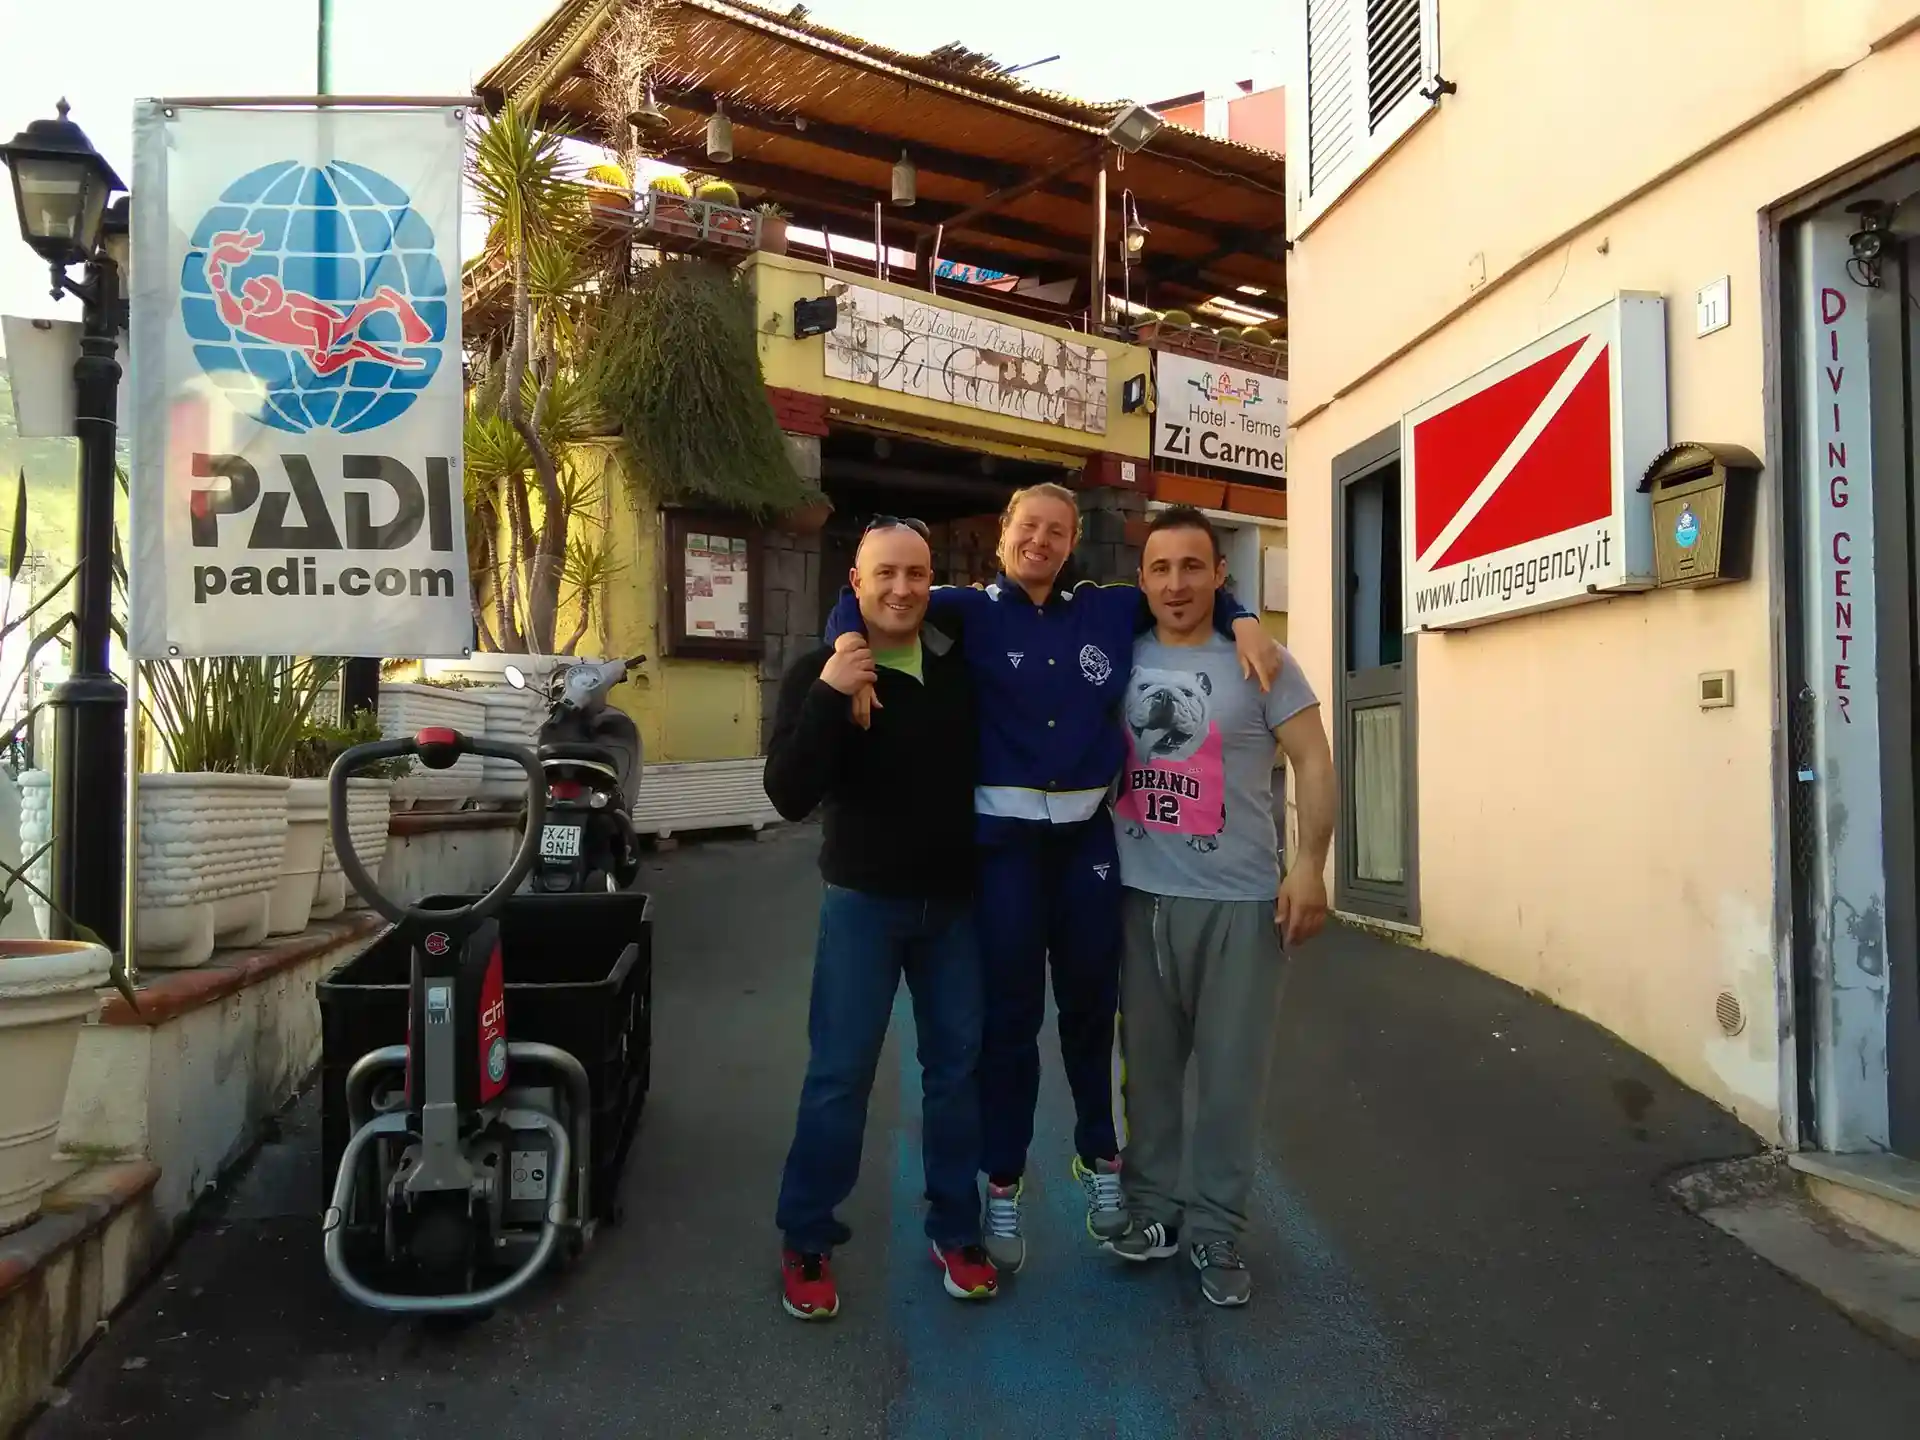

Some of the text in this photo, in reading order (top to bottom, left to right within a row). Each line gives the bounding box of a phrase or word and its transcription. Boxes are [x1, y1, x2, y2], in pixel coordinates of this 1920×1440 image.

[1163, 422, 1191, 455] Zi
[1189, 403, 1226, 428] Hotel
[1238, 413, 1281, 438] Terme
[190, 453, 453, 551] PADI
[1820, 287, 1853, 724] DIVING CENTER
[194, 556, 454, 603] padi.com
[1416, 530, 1611, 614] www.divingagency.it
[1130, 768, 1200, 800] BRAND
[1145, 793, 1180, 826] 12
